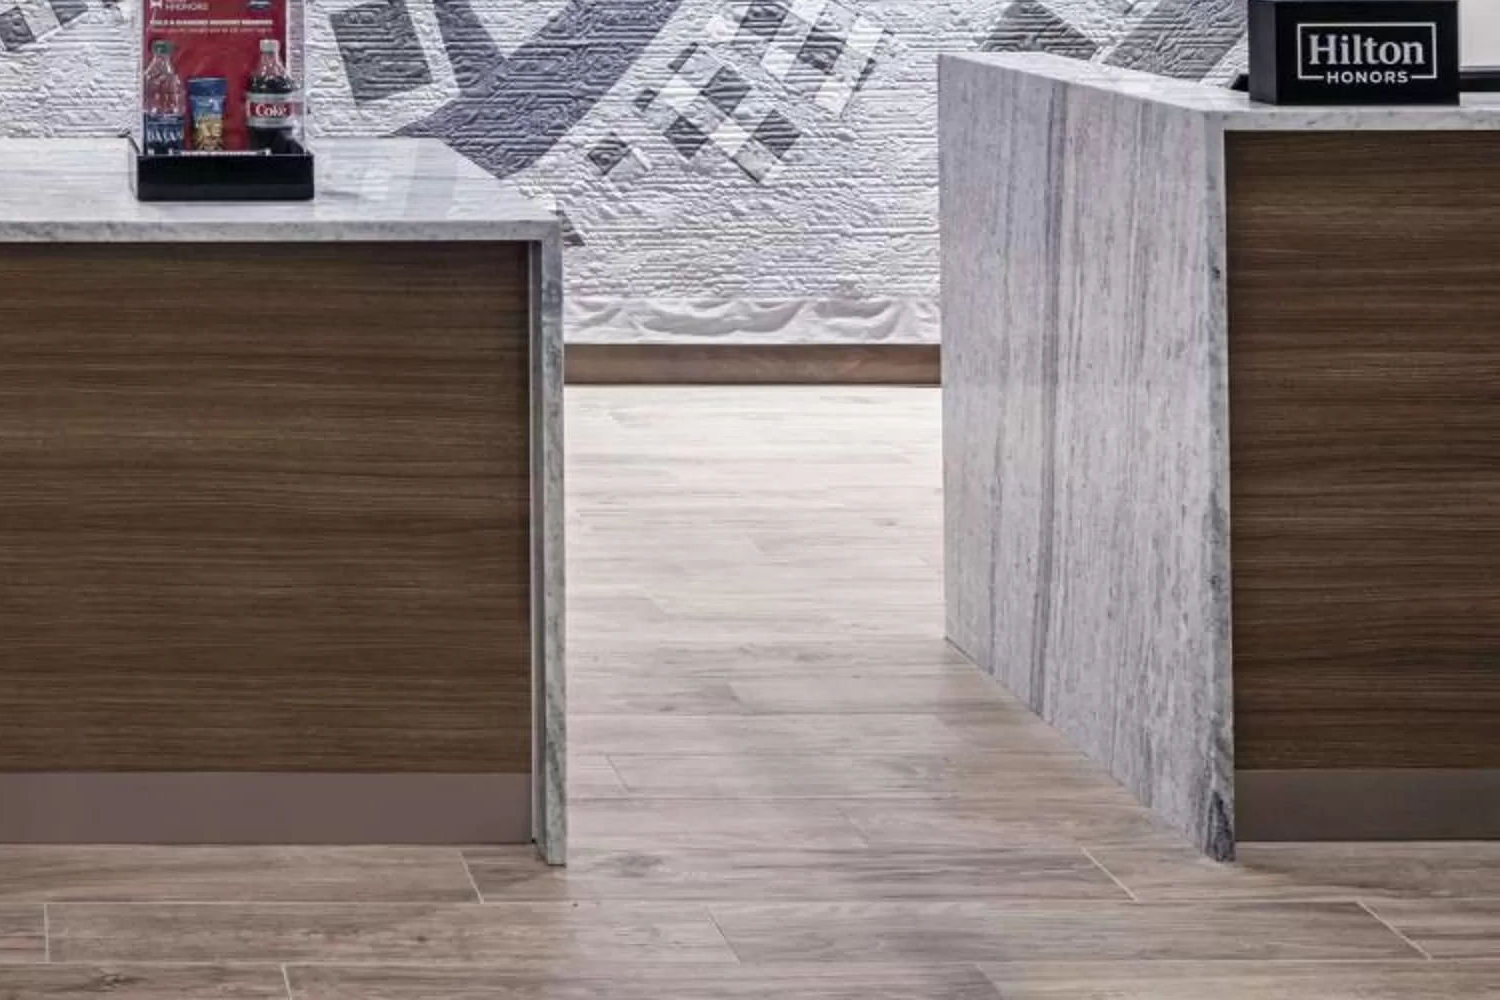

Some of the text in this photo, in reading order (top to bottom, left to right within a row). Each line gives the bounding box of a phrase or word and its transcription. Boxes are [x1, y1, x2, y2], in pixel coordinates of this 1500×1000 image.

[1308, 34, 1425, 65] Hilton
[1327, 71, 1409, 84] HONORS
[255, 103, 288, 118] Coke
